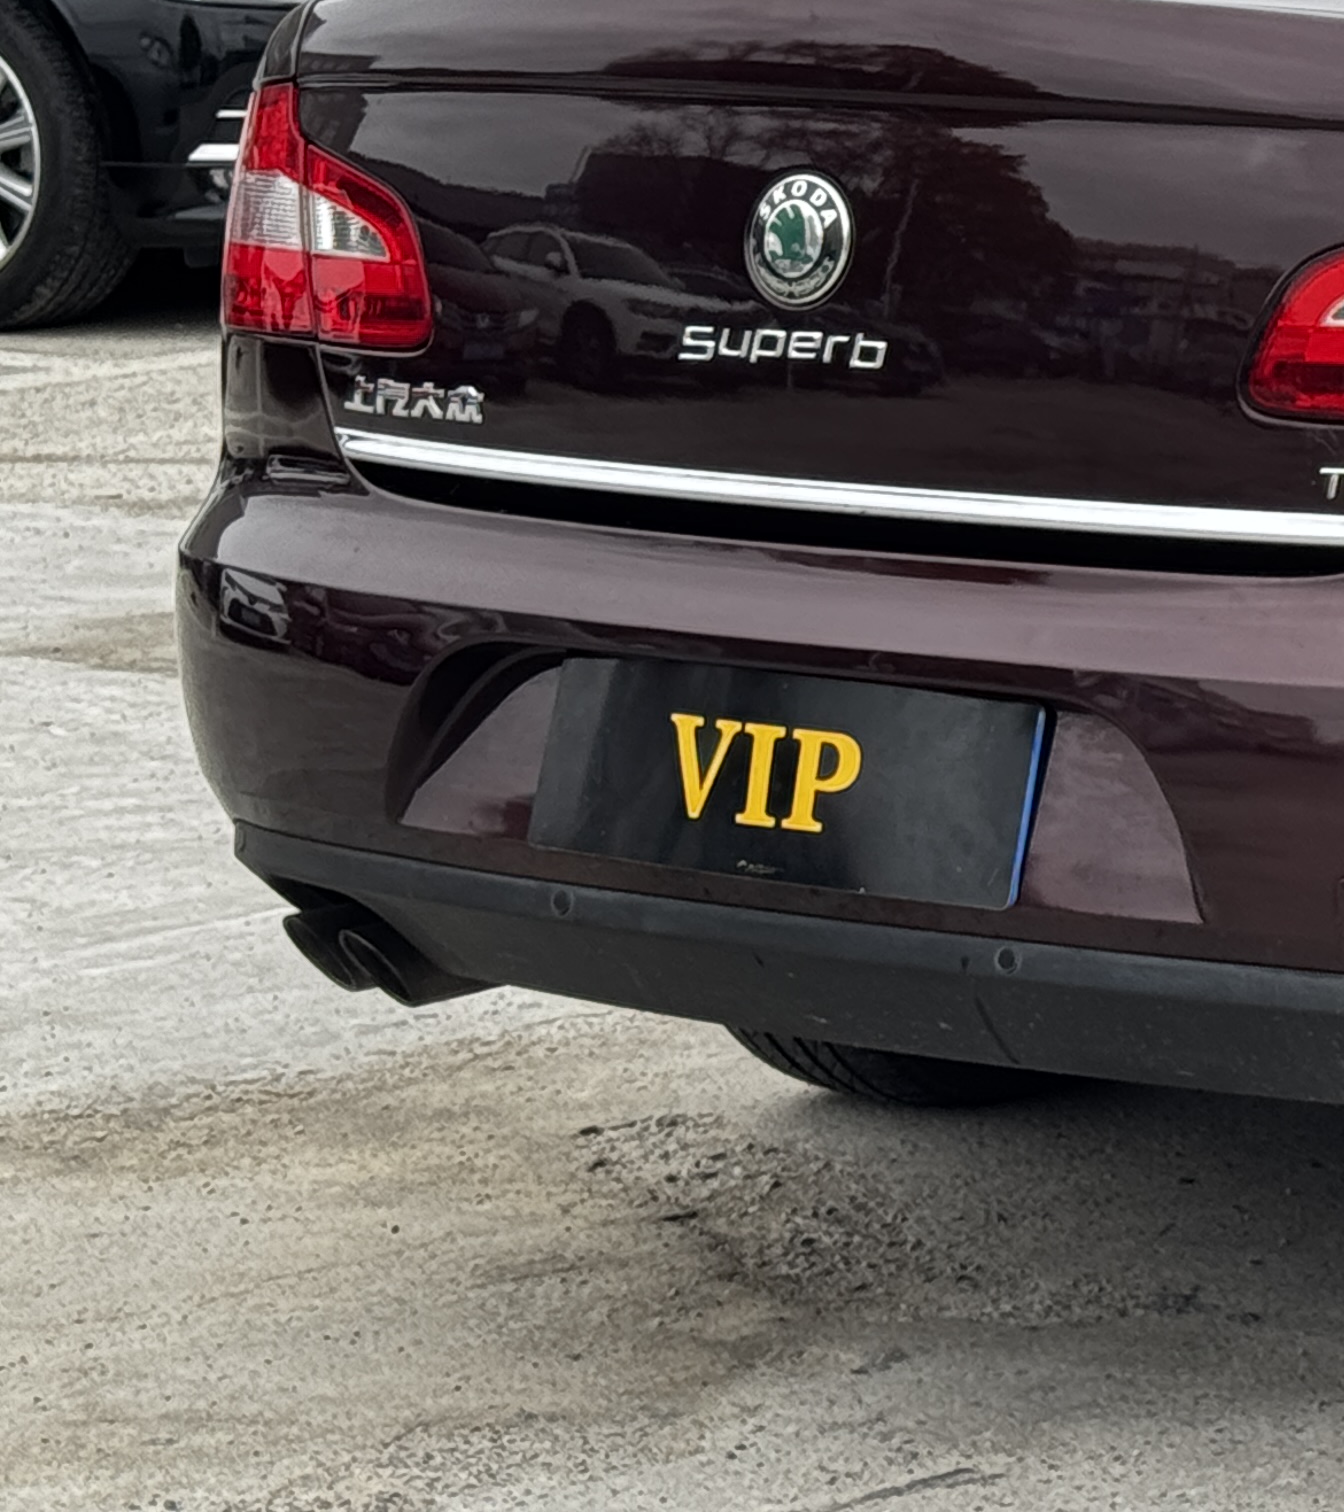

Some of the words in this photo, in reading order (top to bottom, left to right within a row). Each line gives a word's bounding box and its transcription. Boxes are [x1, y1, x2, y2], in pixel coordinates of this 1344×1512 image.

[677, 325, 888, 370] Superb
[343, 374, 485, 425] 上汽大众
[670, 712, 863, 834] VIP
